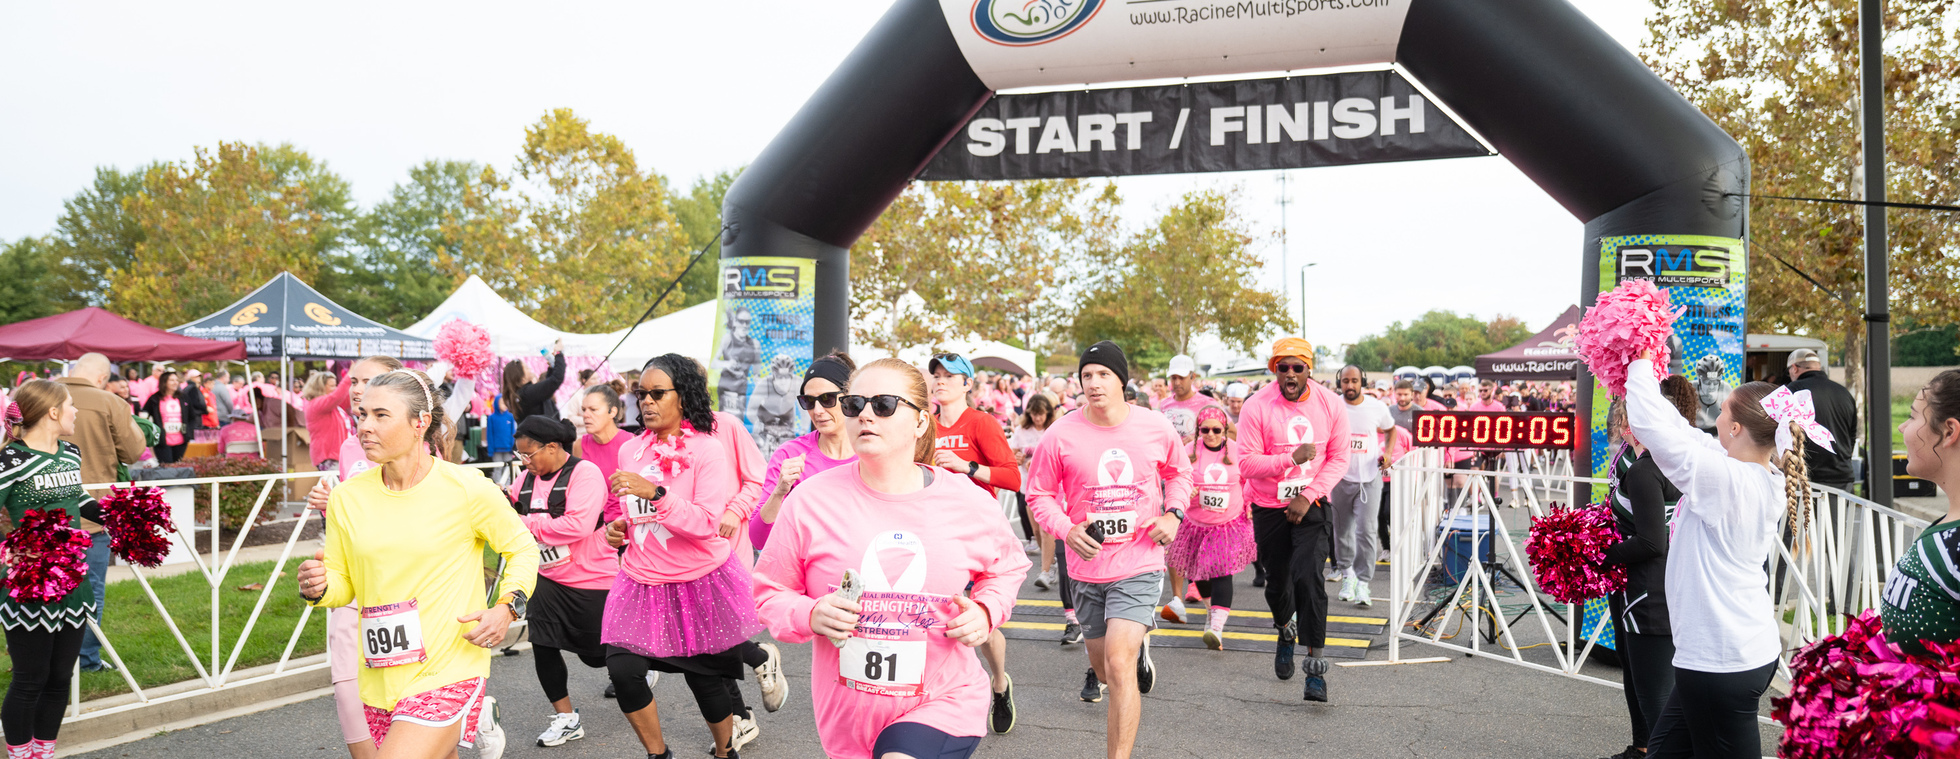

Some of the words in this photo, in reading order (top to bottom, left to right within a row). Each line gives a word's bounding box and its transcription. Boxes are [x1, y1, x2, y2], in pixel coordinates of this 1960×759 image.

[967, 111, 1152, 156] START
[1169, 108, 1190, 149] /
[1210, 94, 1425, 146] FINISH
[1621, 249, 1726, 277] RMS
[725, 268, 796, 292] RMS
[766, 328, 784, 340] FOR
[1691, 323, 1713, 336] FOR
[1417, 415, 1569, 445] 00:00:05
[1204, 495, 1223, 507] 532
[860, 600, 910, 613] TRENGTH
[366, 624, 410, 655] 694
[857, 626, 909, 636] STRENGTH
[864, 651, 898, 682] 81
[856, 685, 880, 694] BREAST
